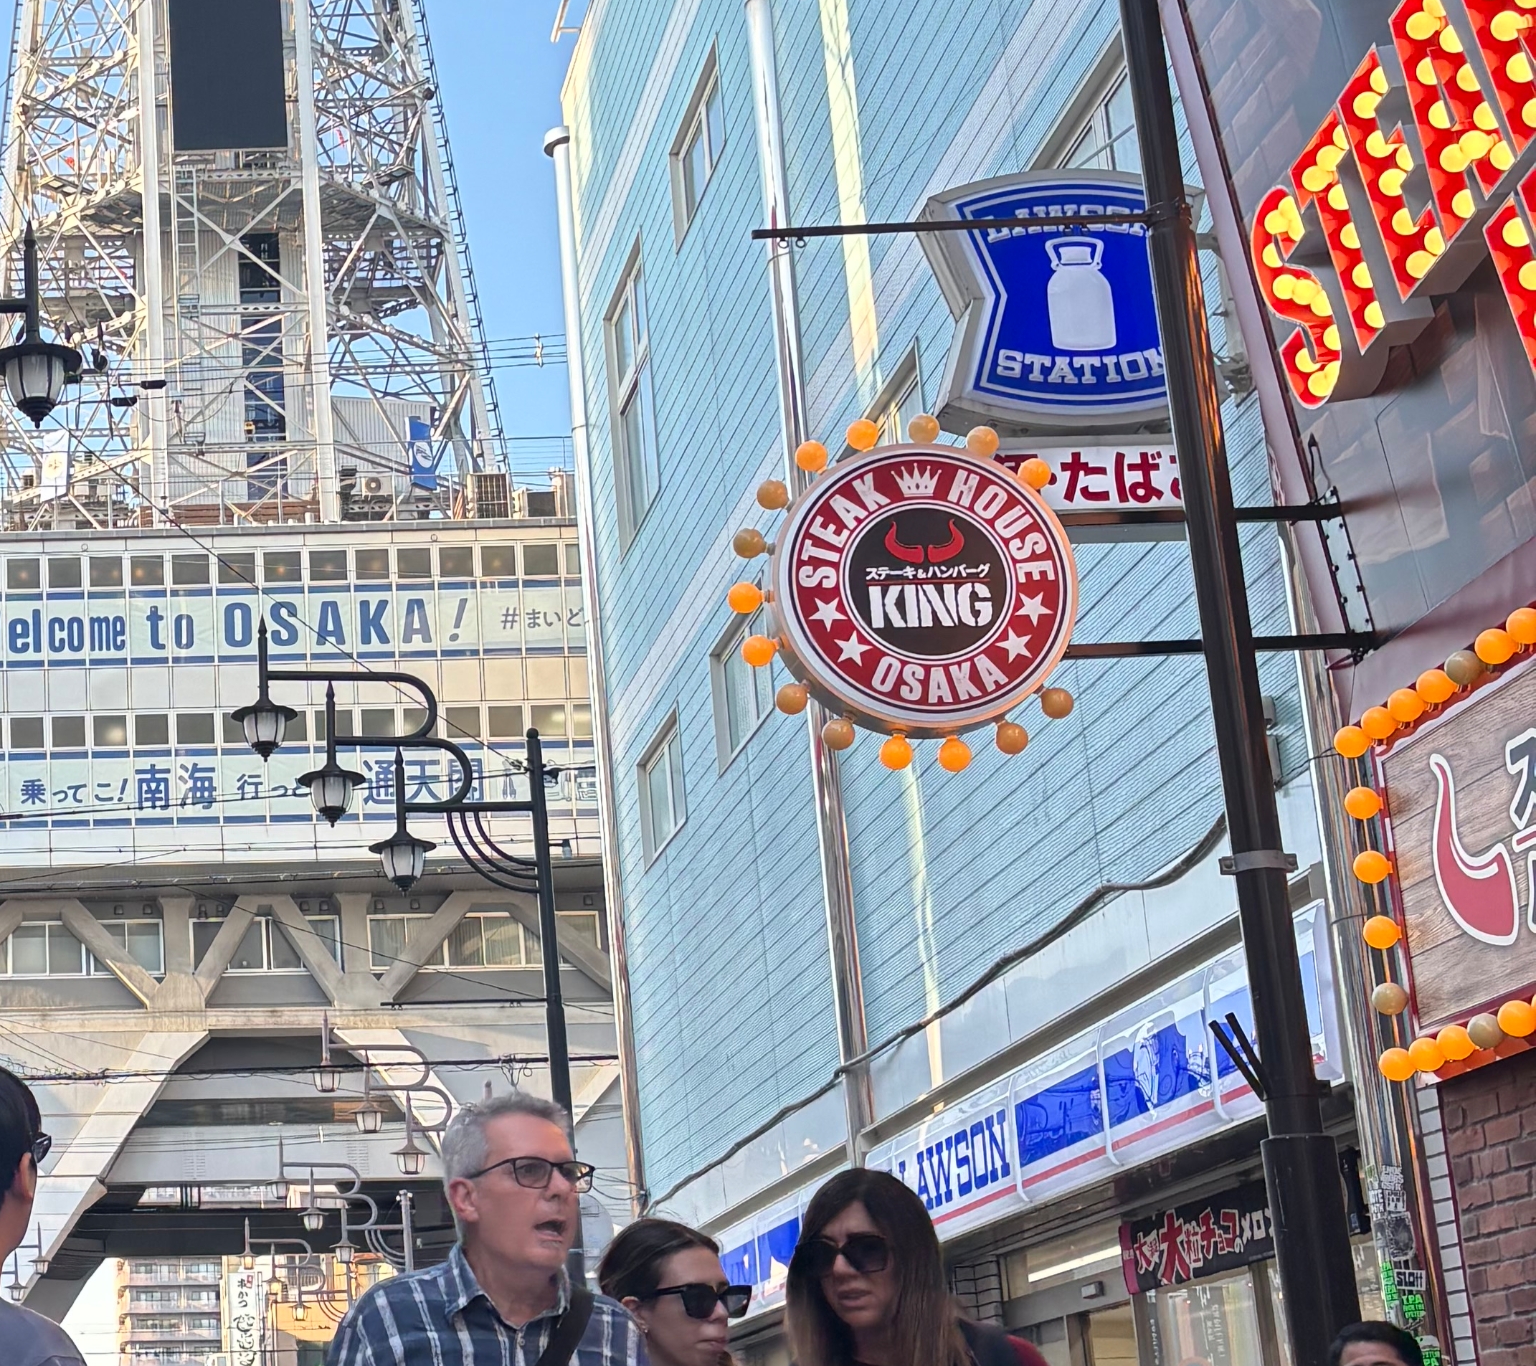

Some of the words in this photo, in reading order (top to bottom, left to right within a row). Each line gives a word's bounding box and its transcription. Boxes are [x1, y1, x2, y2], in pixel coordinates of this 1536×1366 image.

[994, 451, 1182, 504] ・たば
[798, 471, 890, 589] STEAK
[947, 469, 1055, 584] HOUSE
[865, 562, 991, 580] ステーキ&ハンバーグ
[146, 605, 194, 649] to
[224, 598, 467, 648] OSAKA!
[868, 583, 993, 629] KING
[871, 654, 1009, 704] OSAKA
[20, 778, 129, 805] 乗ってこ!
[135, 762, 217, 810] 南海
[363, 758, 483, 805] 通天閣
